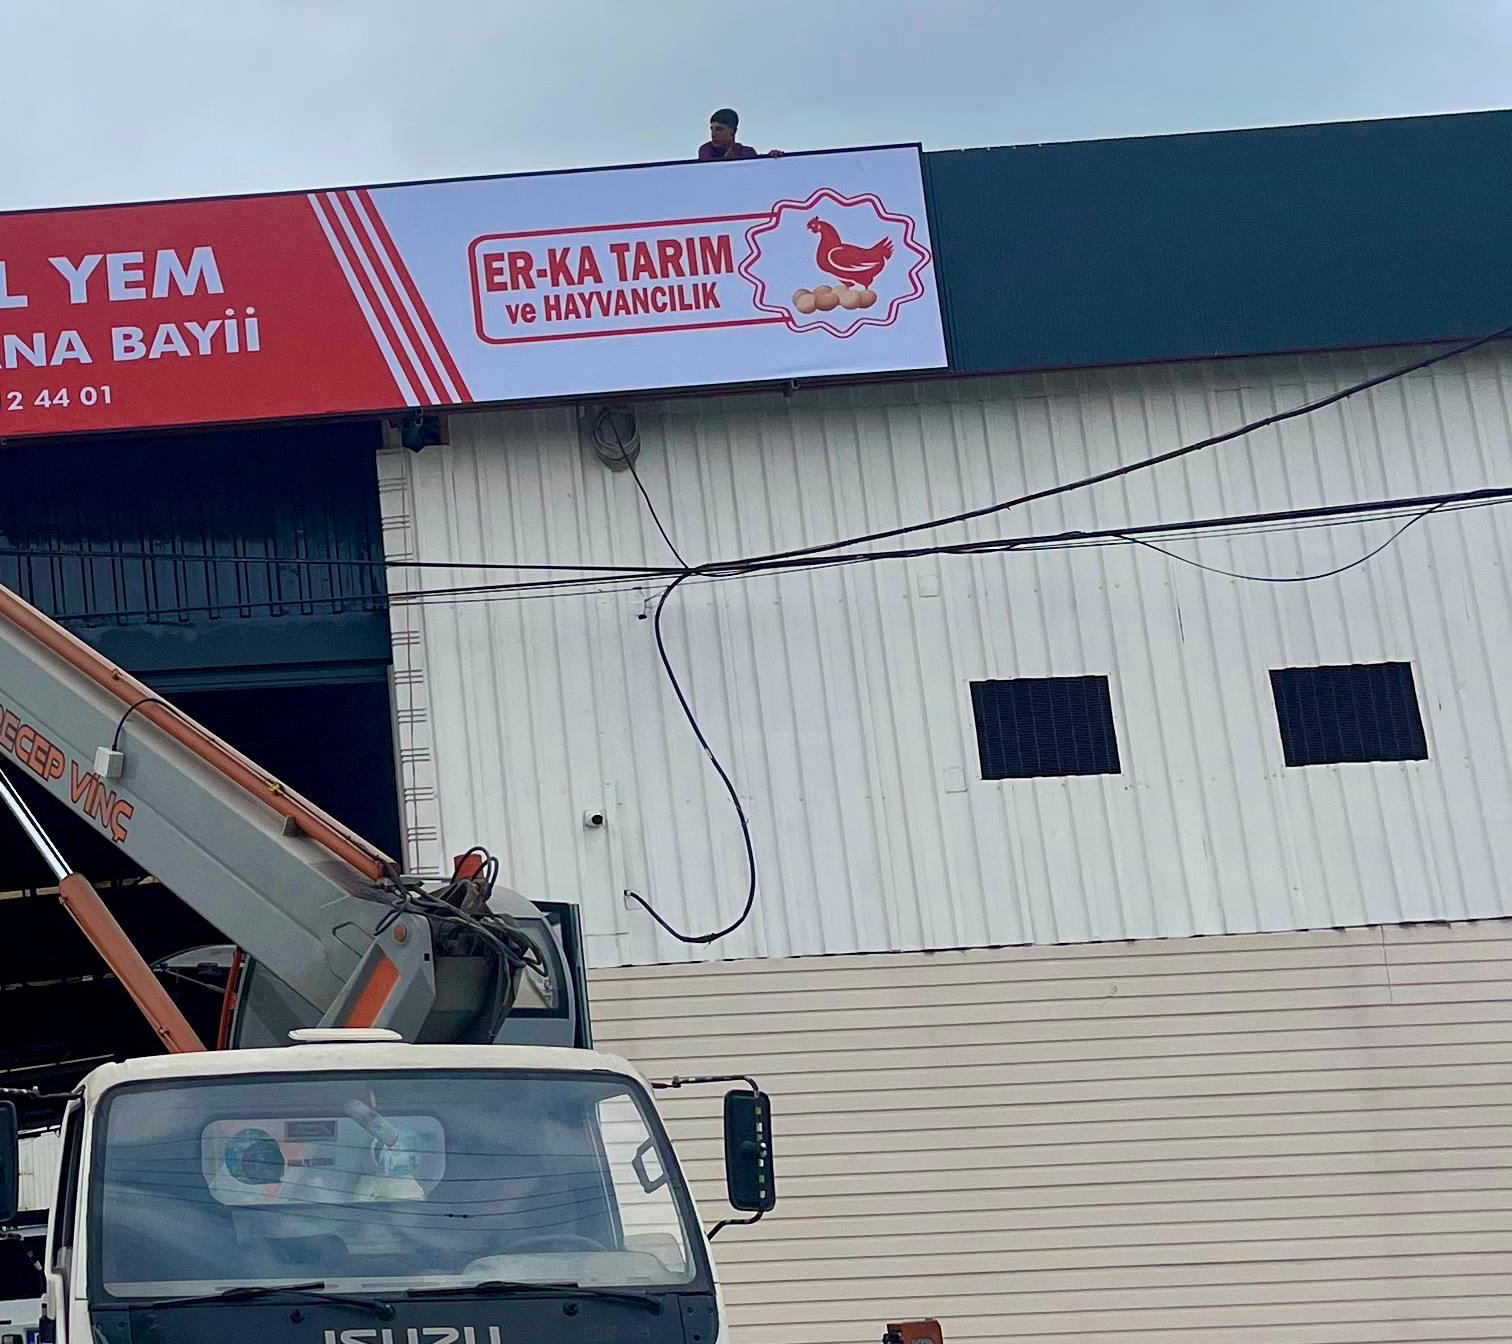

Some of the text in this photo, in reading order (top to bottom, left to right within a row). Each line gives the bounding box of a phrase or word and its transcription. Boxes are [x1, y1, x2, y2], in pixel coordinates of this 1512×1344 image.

[49, 246, 224, 304] YEM
[483, 234, 733, 293] ER-KA TARIM
[505, 281, 721, 324] ve HAYVANCILIK
[34, 388, 70, 409] 44
[80, 385, 113, 406] 01
[71, 760, 135, 843] VİNÇ
